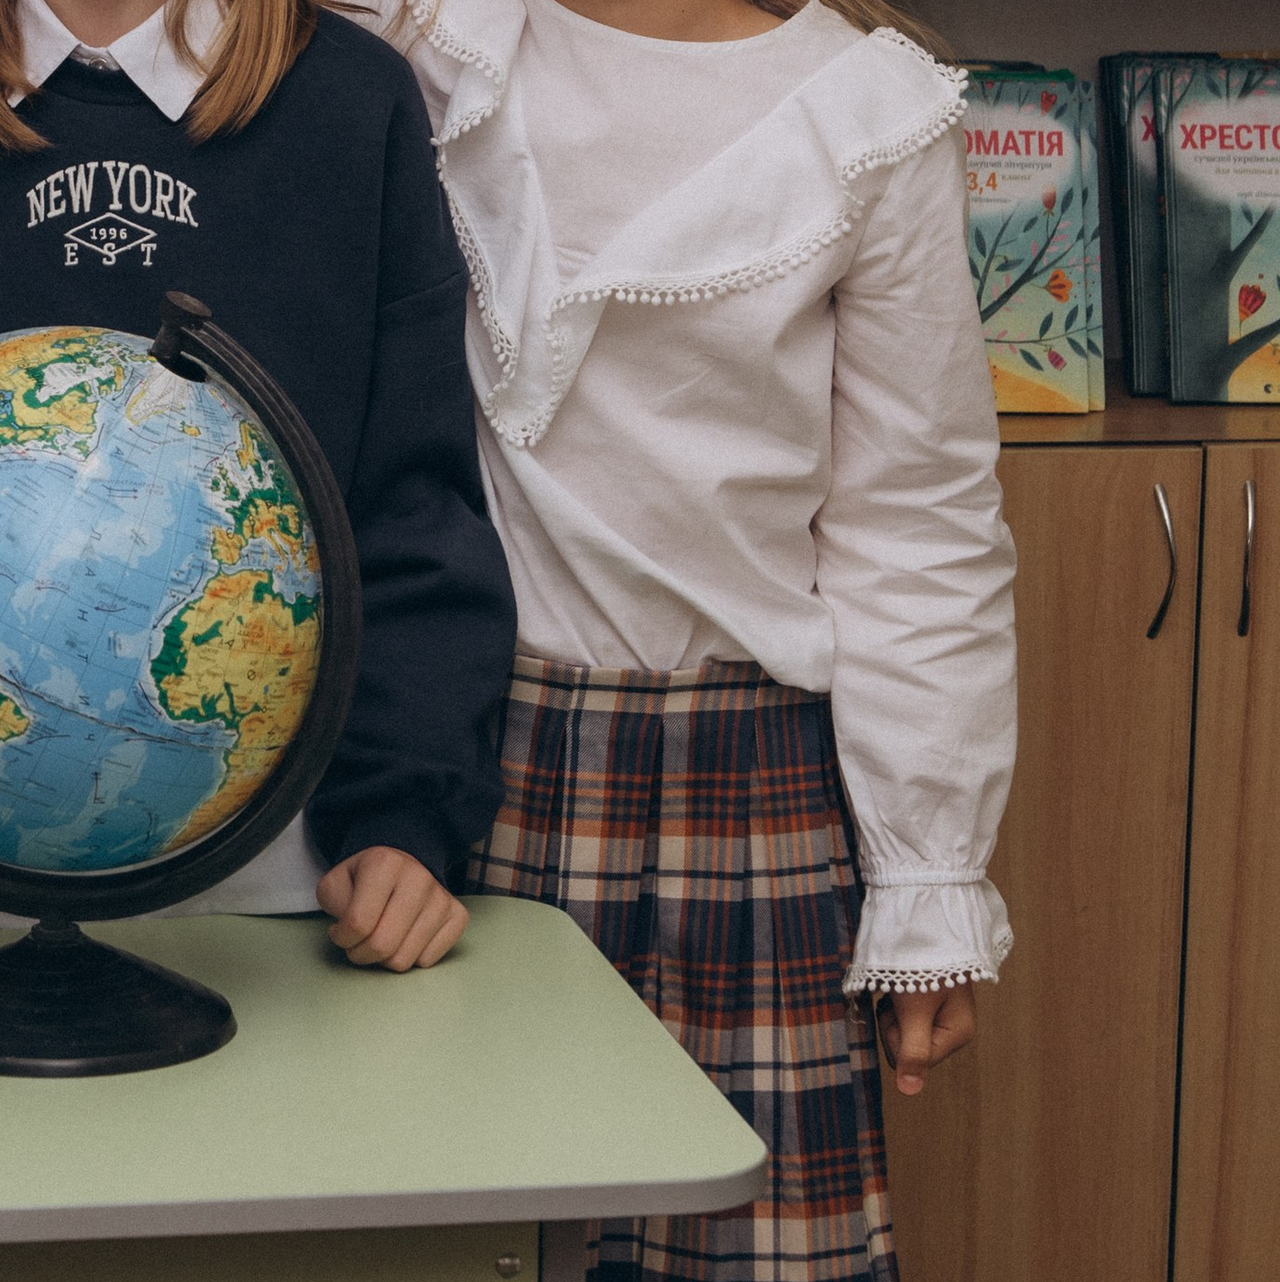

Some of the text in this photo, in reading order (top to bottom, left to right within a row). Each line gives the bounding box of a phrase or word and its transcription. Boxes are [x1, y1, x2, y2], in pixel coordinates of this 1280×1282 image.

[26, 160, 199, 228] NEW YORK
[90, 228, 128, 240] 1996
